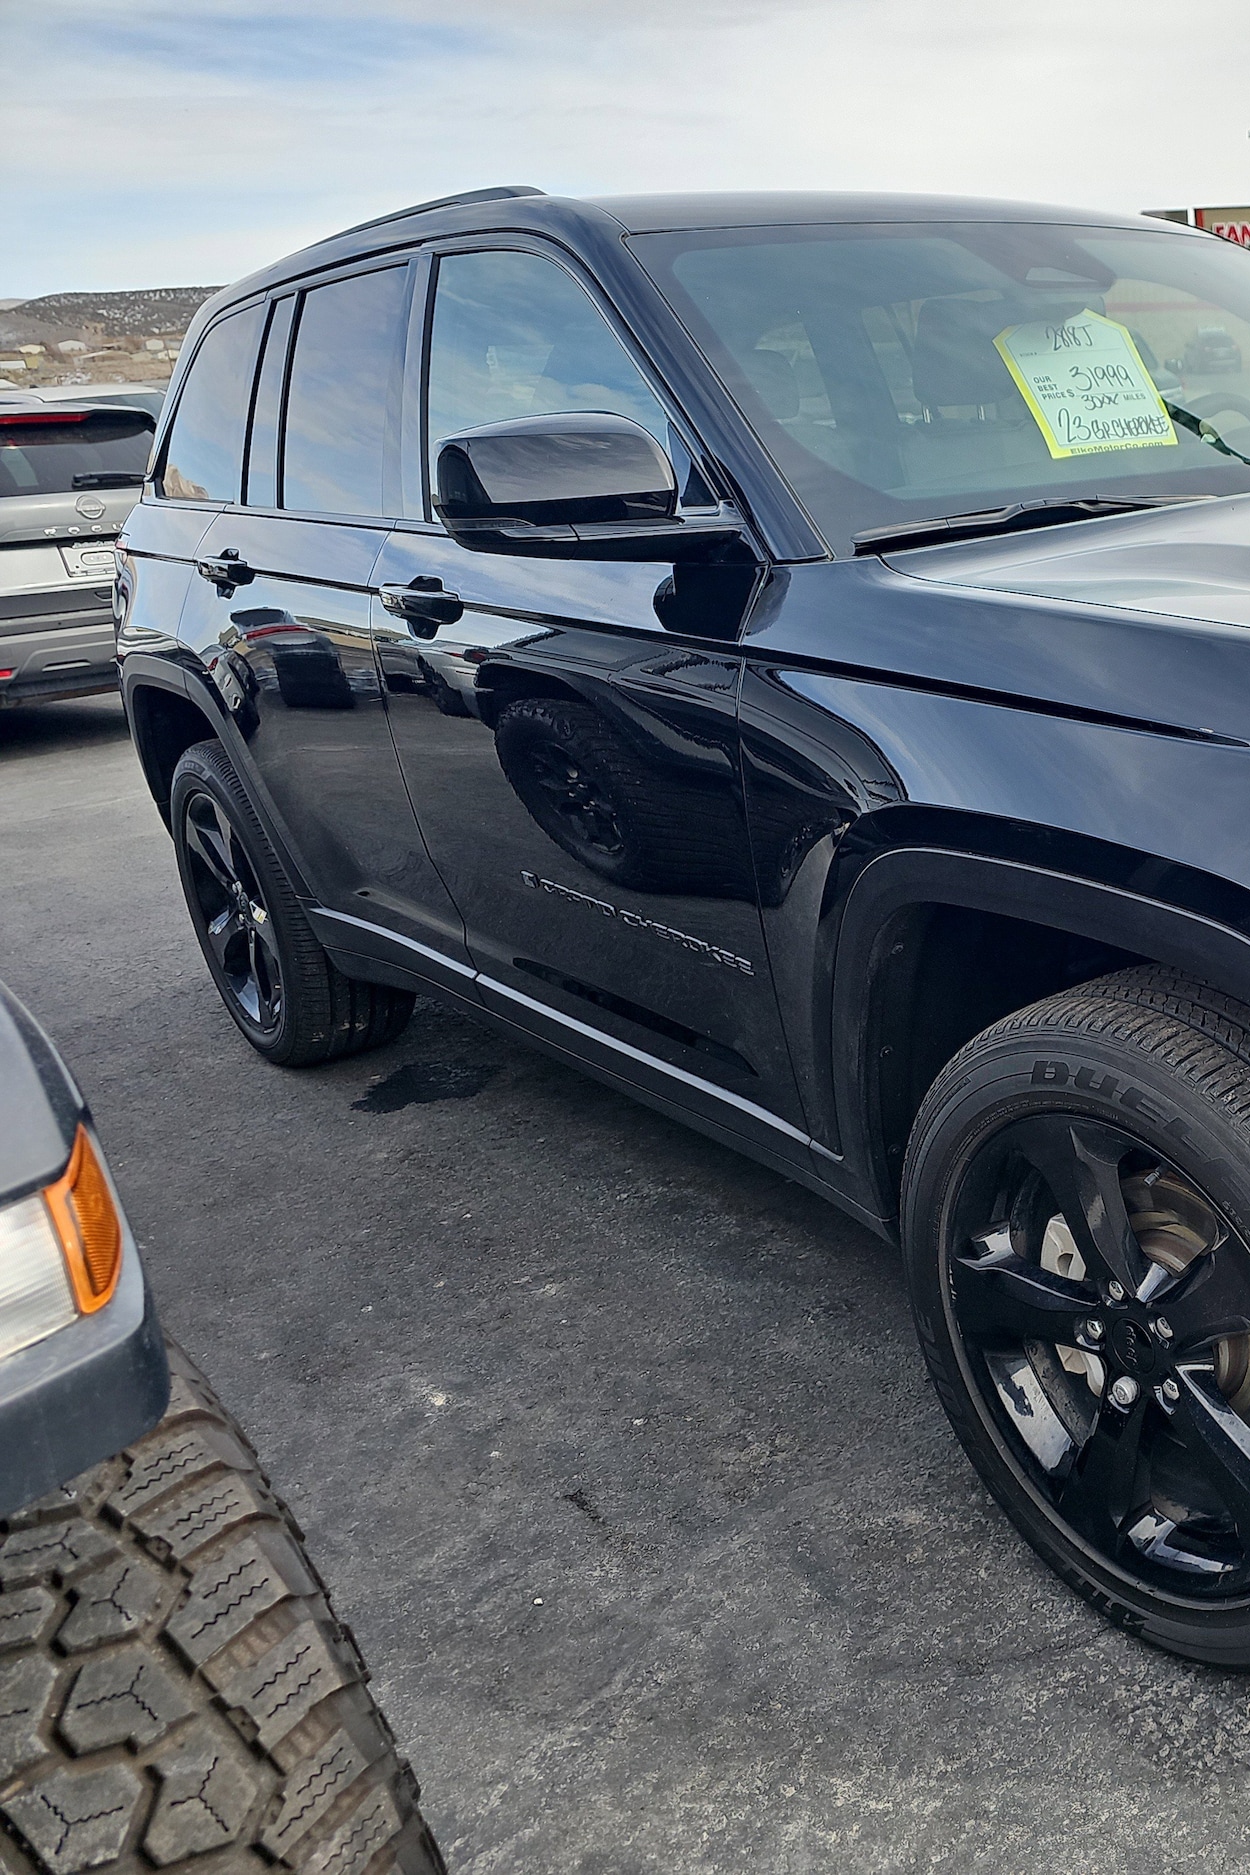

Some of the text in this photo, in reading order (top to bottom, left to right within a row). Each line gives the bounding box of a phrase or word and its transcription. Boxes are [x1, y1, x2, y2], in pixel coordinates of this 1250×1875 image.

[1033, 375, 1052, 384] OUR
[1037, 383, 1058, 392] BEST
[1123, 392, 1147, 401] MILES
[1058, 408, 1091, 442] 23
[44, 523, 124, 537] ROGU
